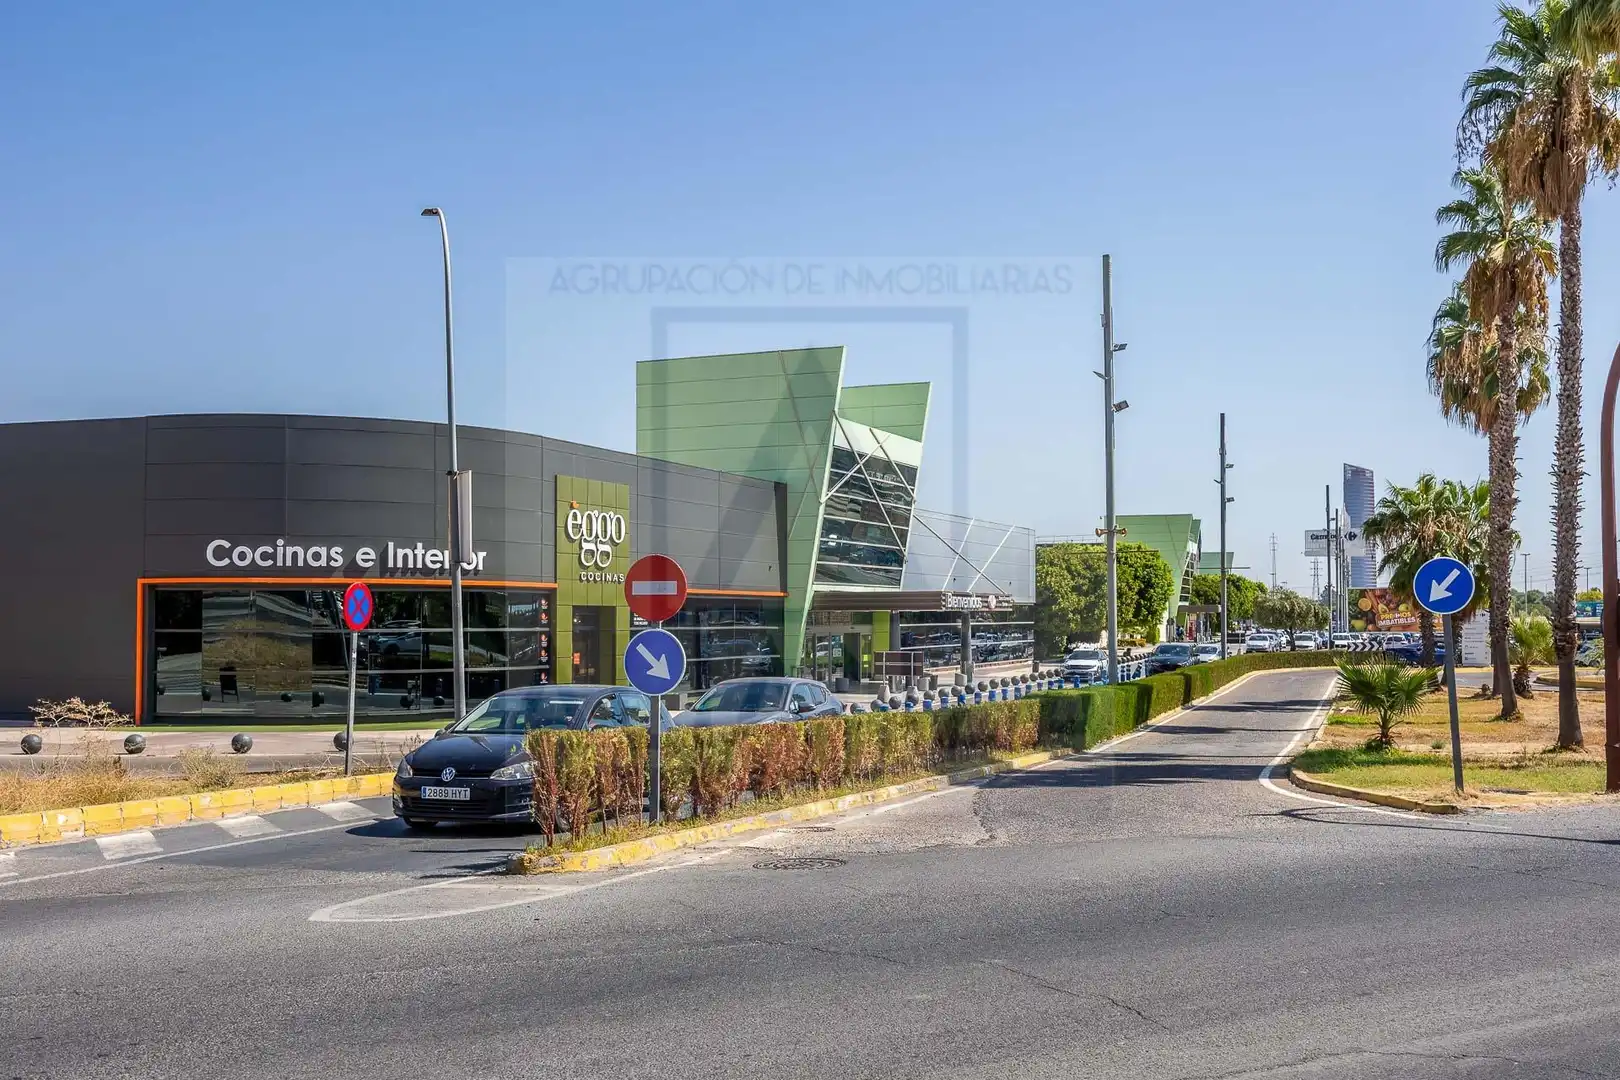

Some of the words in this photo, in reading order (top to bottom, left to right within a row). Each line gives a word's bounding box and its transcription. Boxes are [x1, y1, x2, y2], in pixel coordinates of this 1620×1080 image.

[206, 539, 344, 567] Cocinas
[355, 547, 377, 568] e
[388, 541, 487, 570] Interor
[581, 571, 625, 582] COCINAS
[427, 788, 449, 798] 2889
[451, 789, 469, 799] HYT
